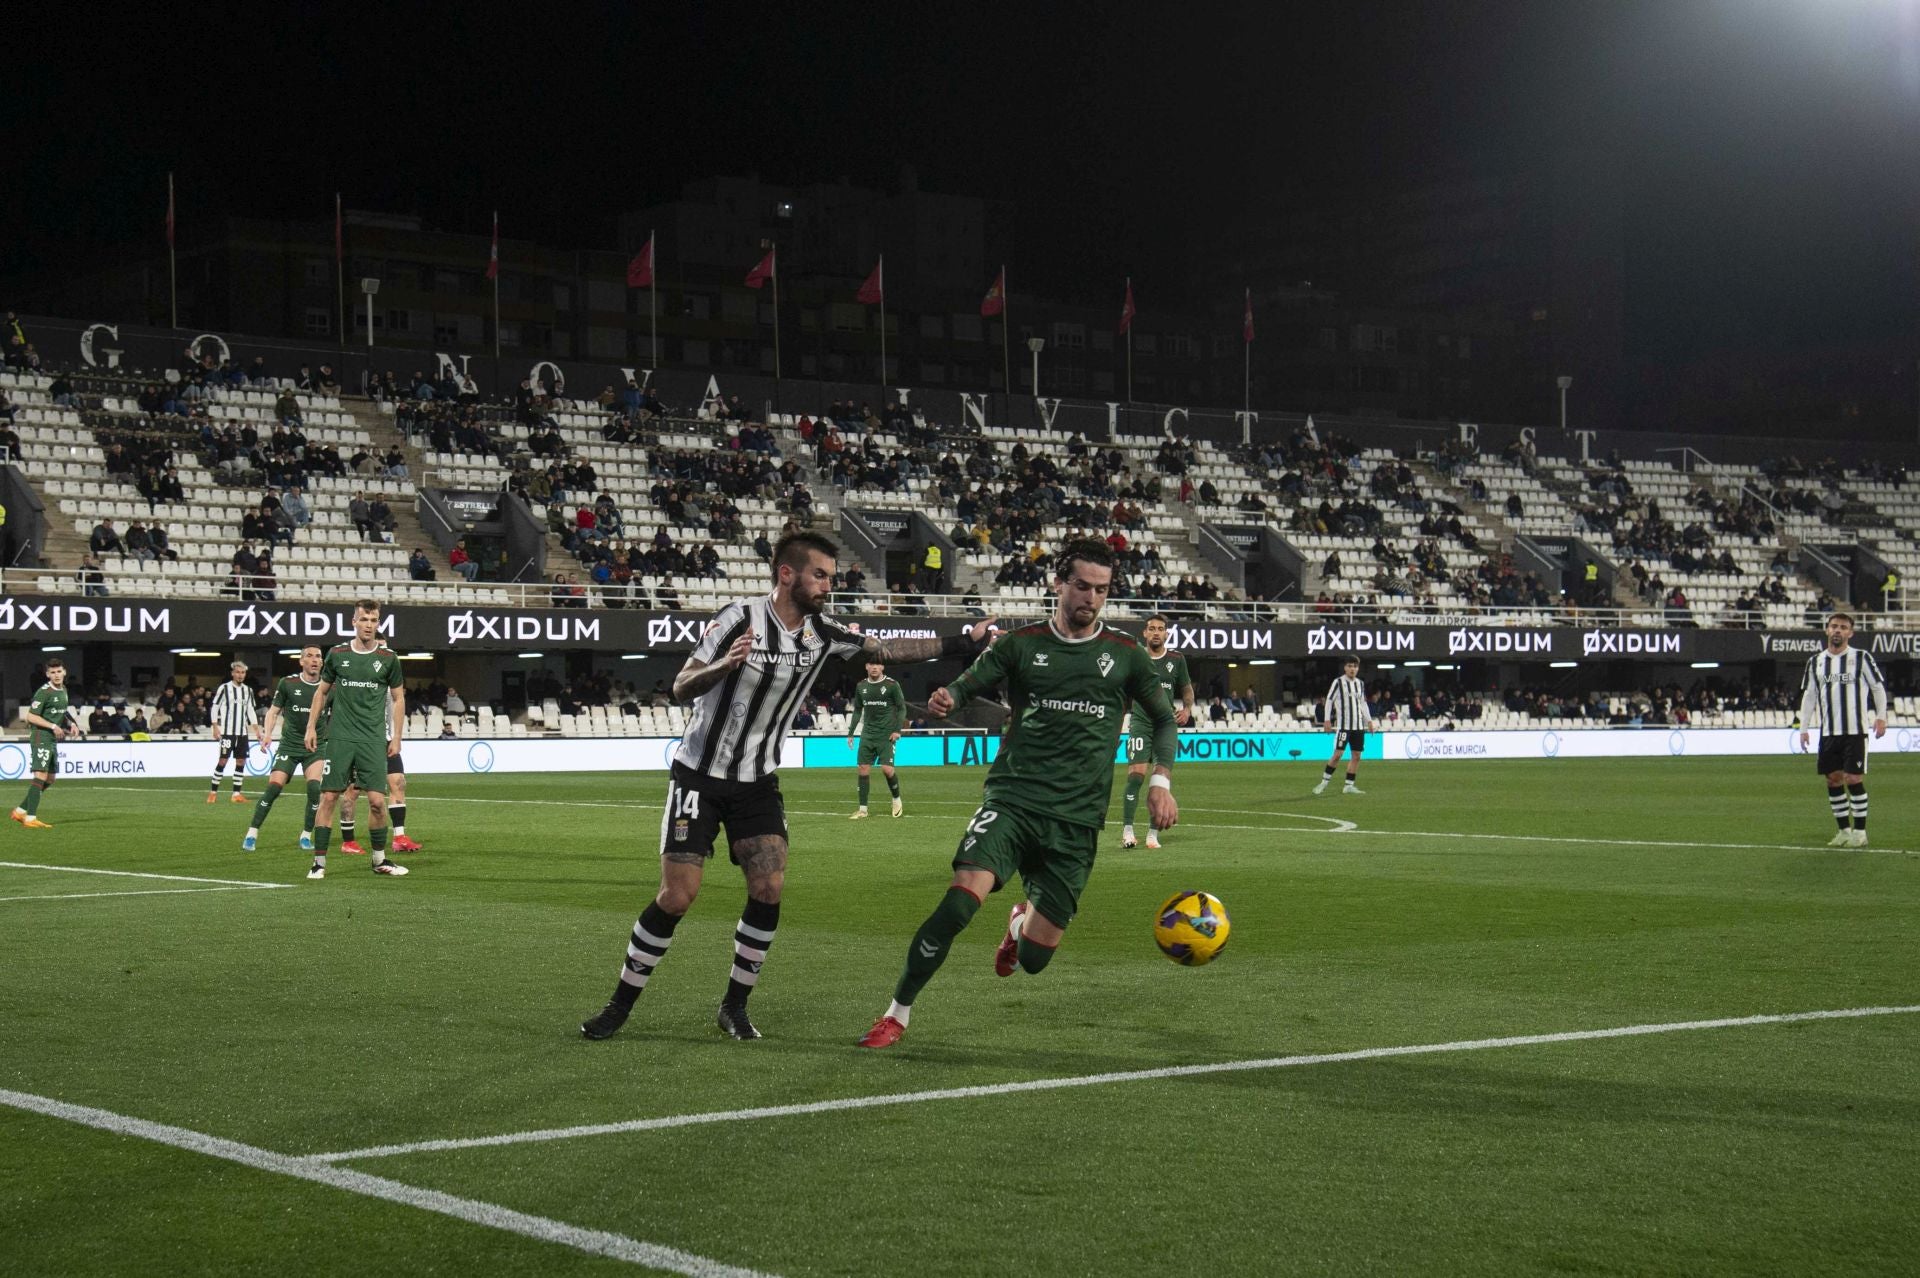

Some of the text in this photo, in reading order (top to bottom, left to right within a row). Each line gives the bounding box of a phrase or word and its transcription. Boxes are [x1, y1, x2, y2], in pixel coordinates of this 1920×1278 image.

[880, 629, 937, 639] CARTAGENA
[1772, 638, 1823, 652] ESTAVESA
[1041, 698, 1104, 719] smartlog
[1131, 737, 1144, 751] 10
[1455, 744, 1487, 755] MURCIA
[65, 761, 83, 773] DE
[88, 760, 145, 774] MURCIA
[674, 787, 699, 809] 14
